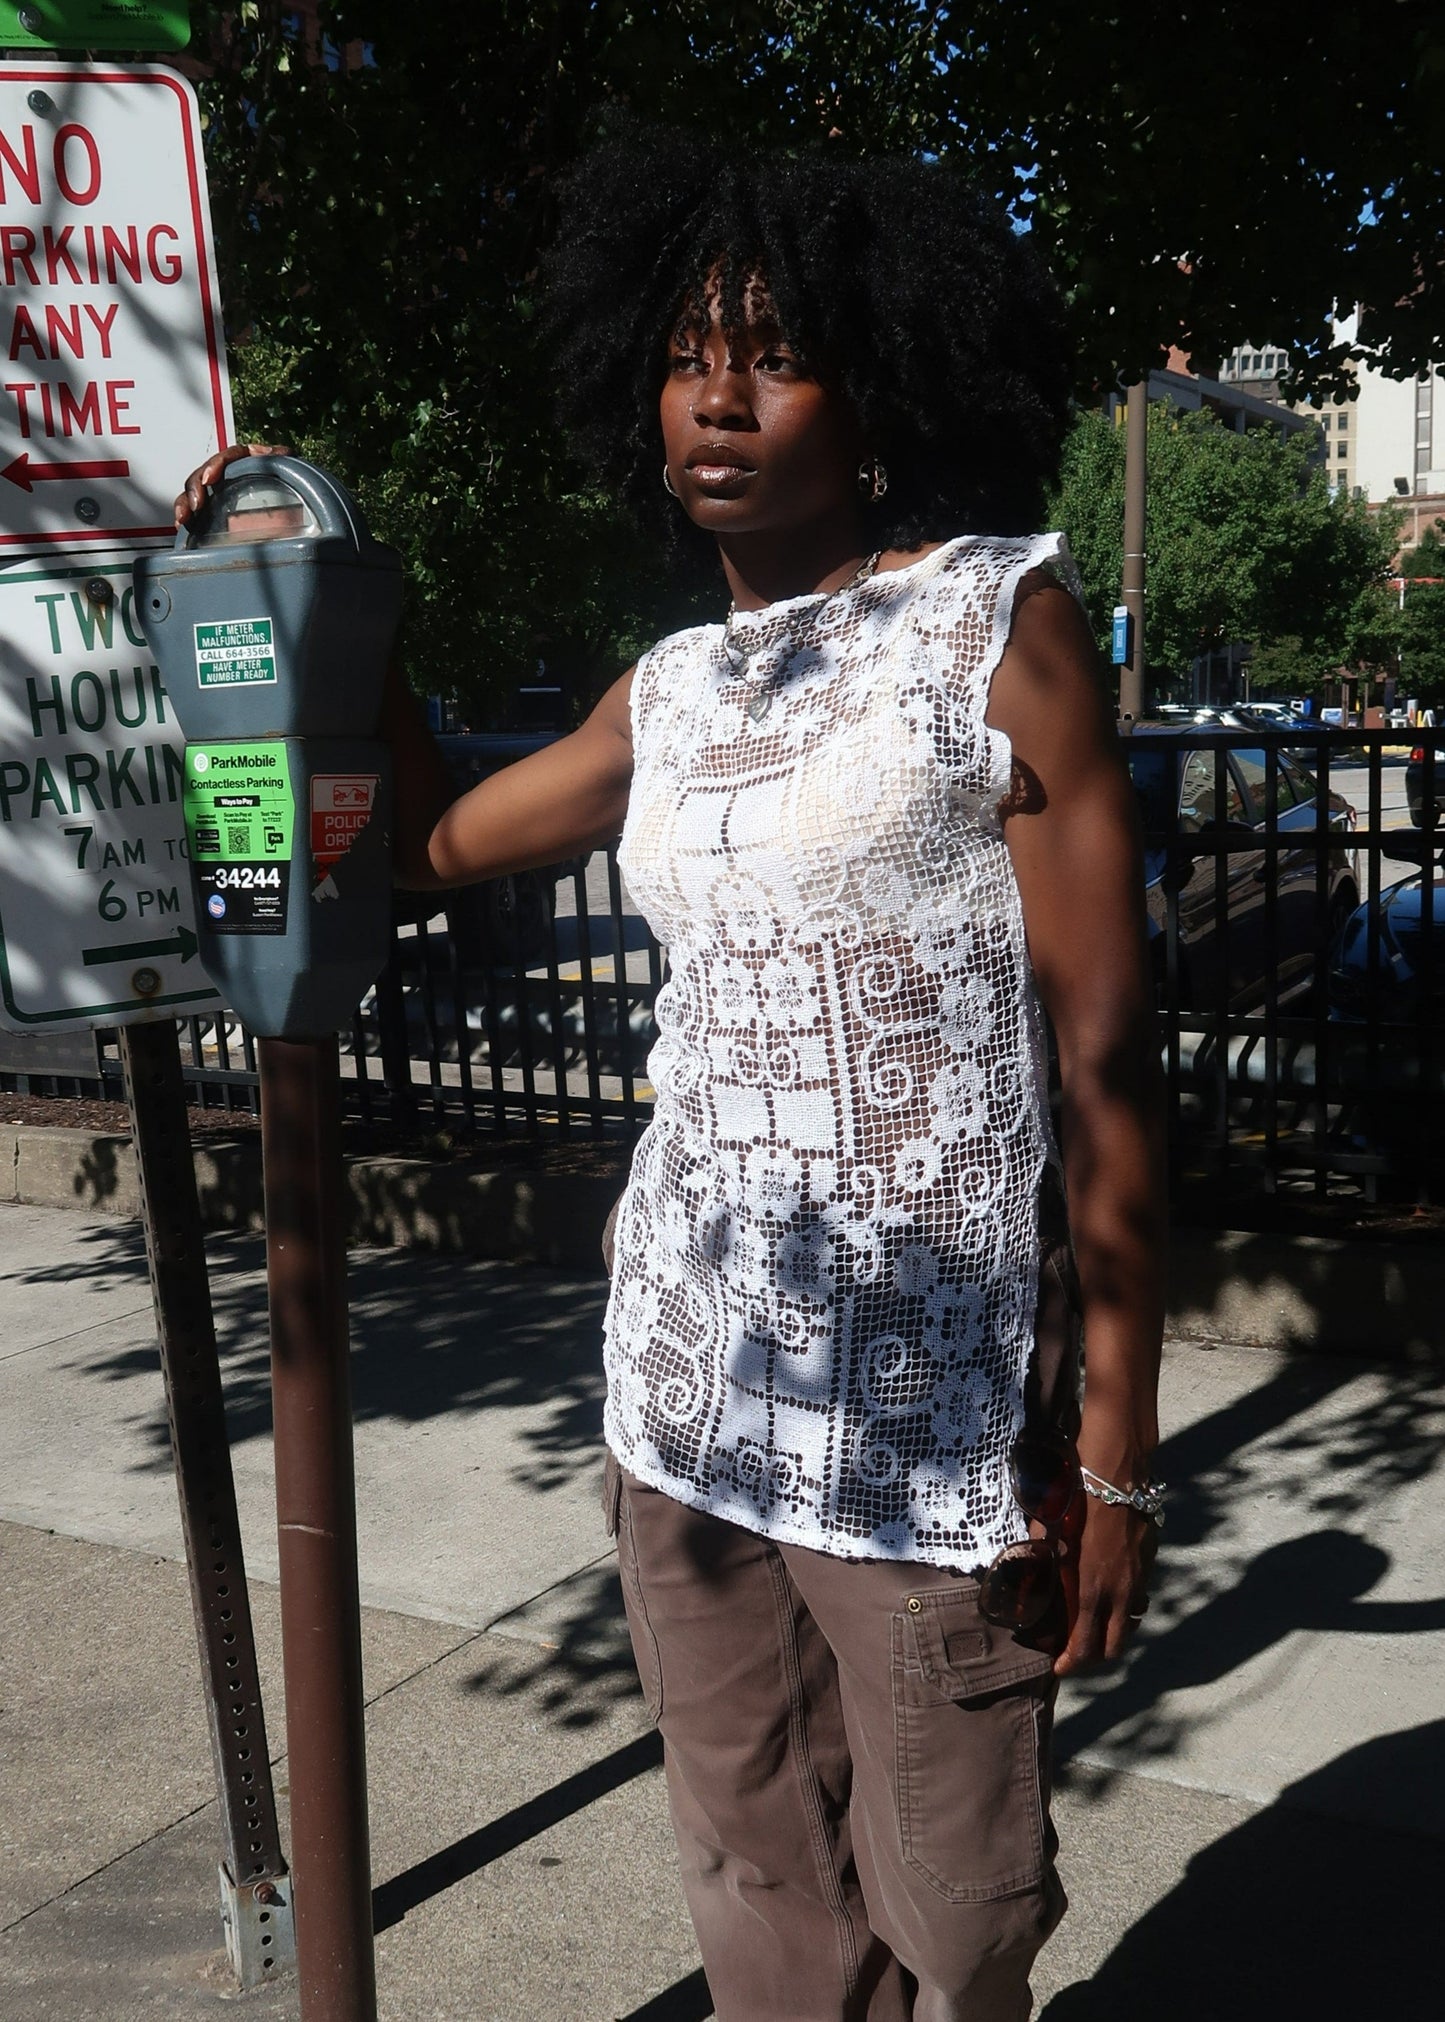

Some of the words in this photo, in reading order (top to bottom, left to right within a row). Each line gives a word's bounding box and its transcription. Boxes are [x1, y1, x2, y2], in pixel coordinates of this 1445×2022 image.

[0, 123, 102, 206] NO
[0, 224, 183, 286] RKING
[8, 303, 119, 361] ANY
[4, 380, 141, 439] TIME
[215, 626, 223, 636] IF
[226, 623, 254, 635] METER
[200, 650, 224, 661] CALL
[225, 646, 271, 659] 664-3566
[212, 661, 233, 672] HAVE
[236, 659, 262, 670] METER
[206, 671, 241, 683] NUMBER
[243, 668, 269, 680] READY
[211, 754, 276, 769] ParkMobile
[190, 778, 246, 790] Contactless
[246, 777, 284, 789] Parking
[220, 798, 236, 806] Ways
[242, 797, 254, 806] Pay
[325, 814, 371, 829] POLIC
[325, 832, 360, 847] ORD
[64, 826, 94, 870] 7
[102, 838, 146, 869] AM
[215, 867, 282, 889] 34244
[98, 878, 128, 922] 6
[136, 886, 180, 917] PM
